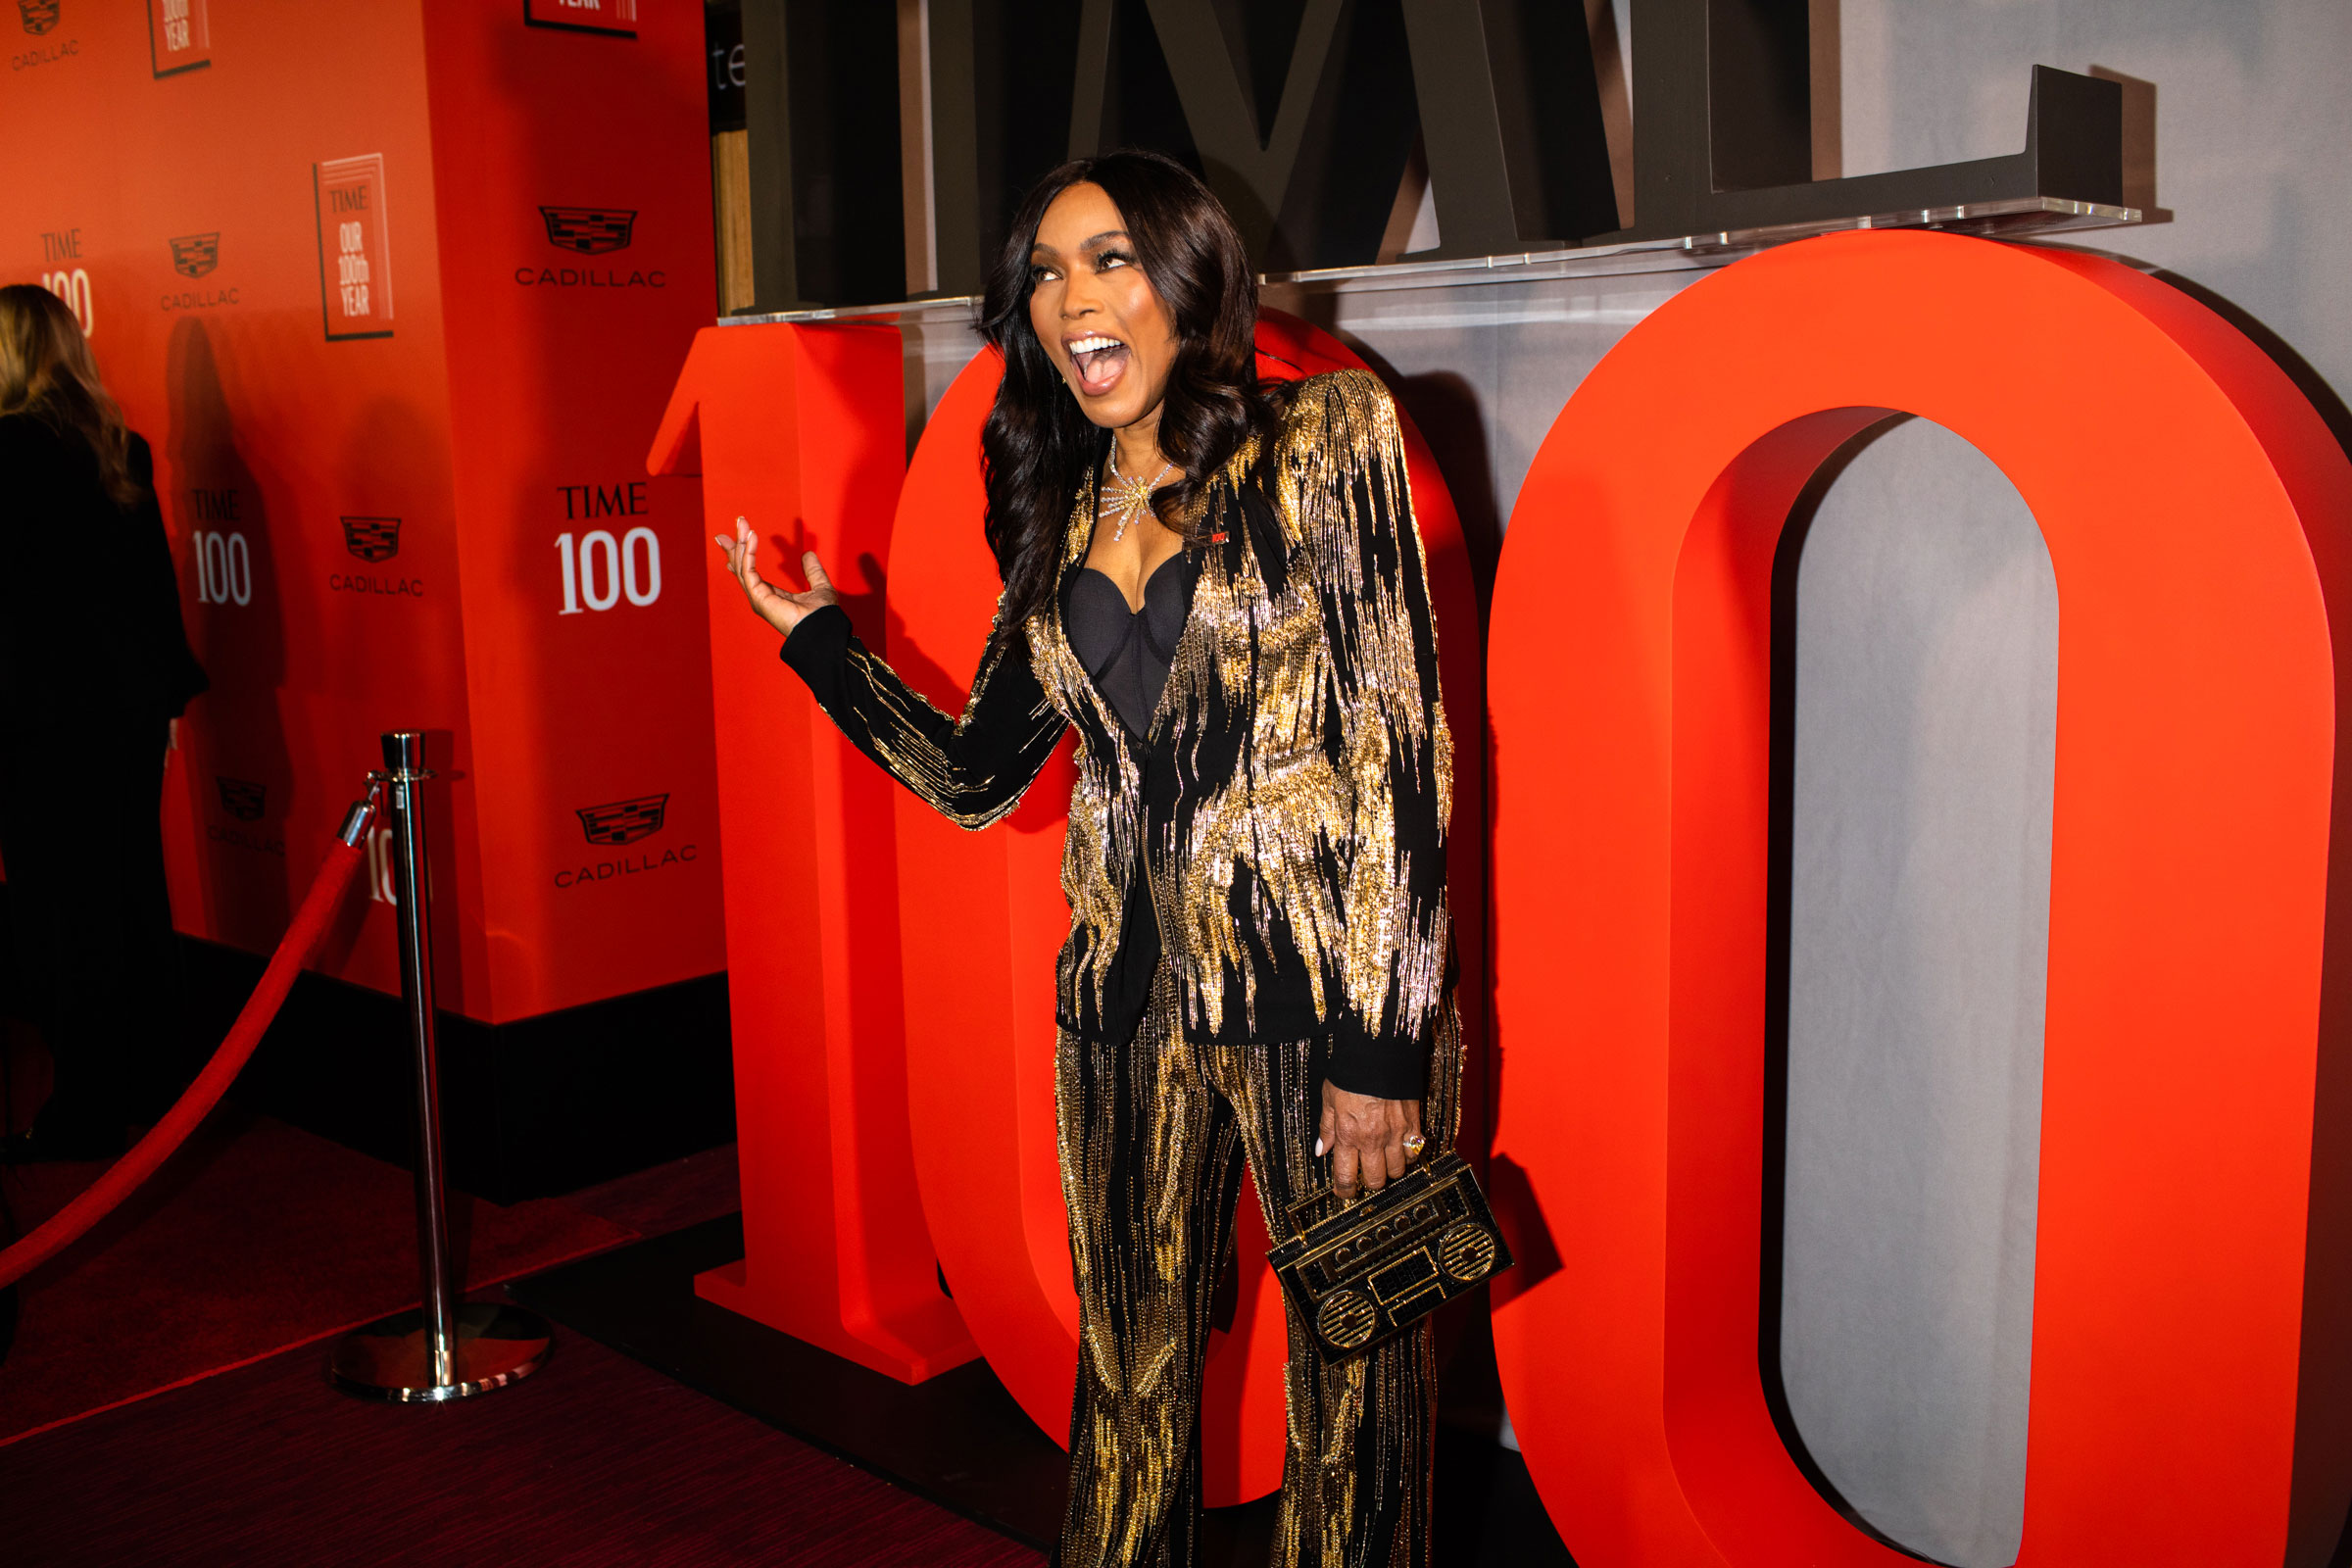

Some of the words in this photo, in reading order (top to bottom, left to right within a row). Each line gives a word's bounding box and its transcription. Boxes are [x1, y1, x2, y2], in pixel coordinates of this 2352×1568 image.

[12, 40, 79, 71] CADILLAC
[328, 185, 368, 213] TIME
[40, 228, 83, 263] TIME
[339, 221, 363, 253] OUR
[514, 268, 665, 287] CADILLAC
[42, 268, 93, 339] 00
[161, 288, 239, 312] CADILLAC
[340, 284, 370, 317] YEAR
[193, 490, 241, 522] TIME
[557, 481, 649, 519] TIME
[192, 530, 251, 606] 100
[554, 526, 662, 615] 100
[329, 574, 423, 597] CADILLAC
[367, 825, 433, 906] 10
[554, 845, 698, 888] CADILLAC
